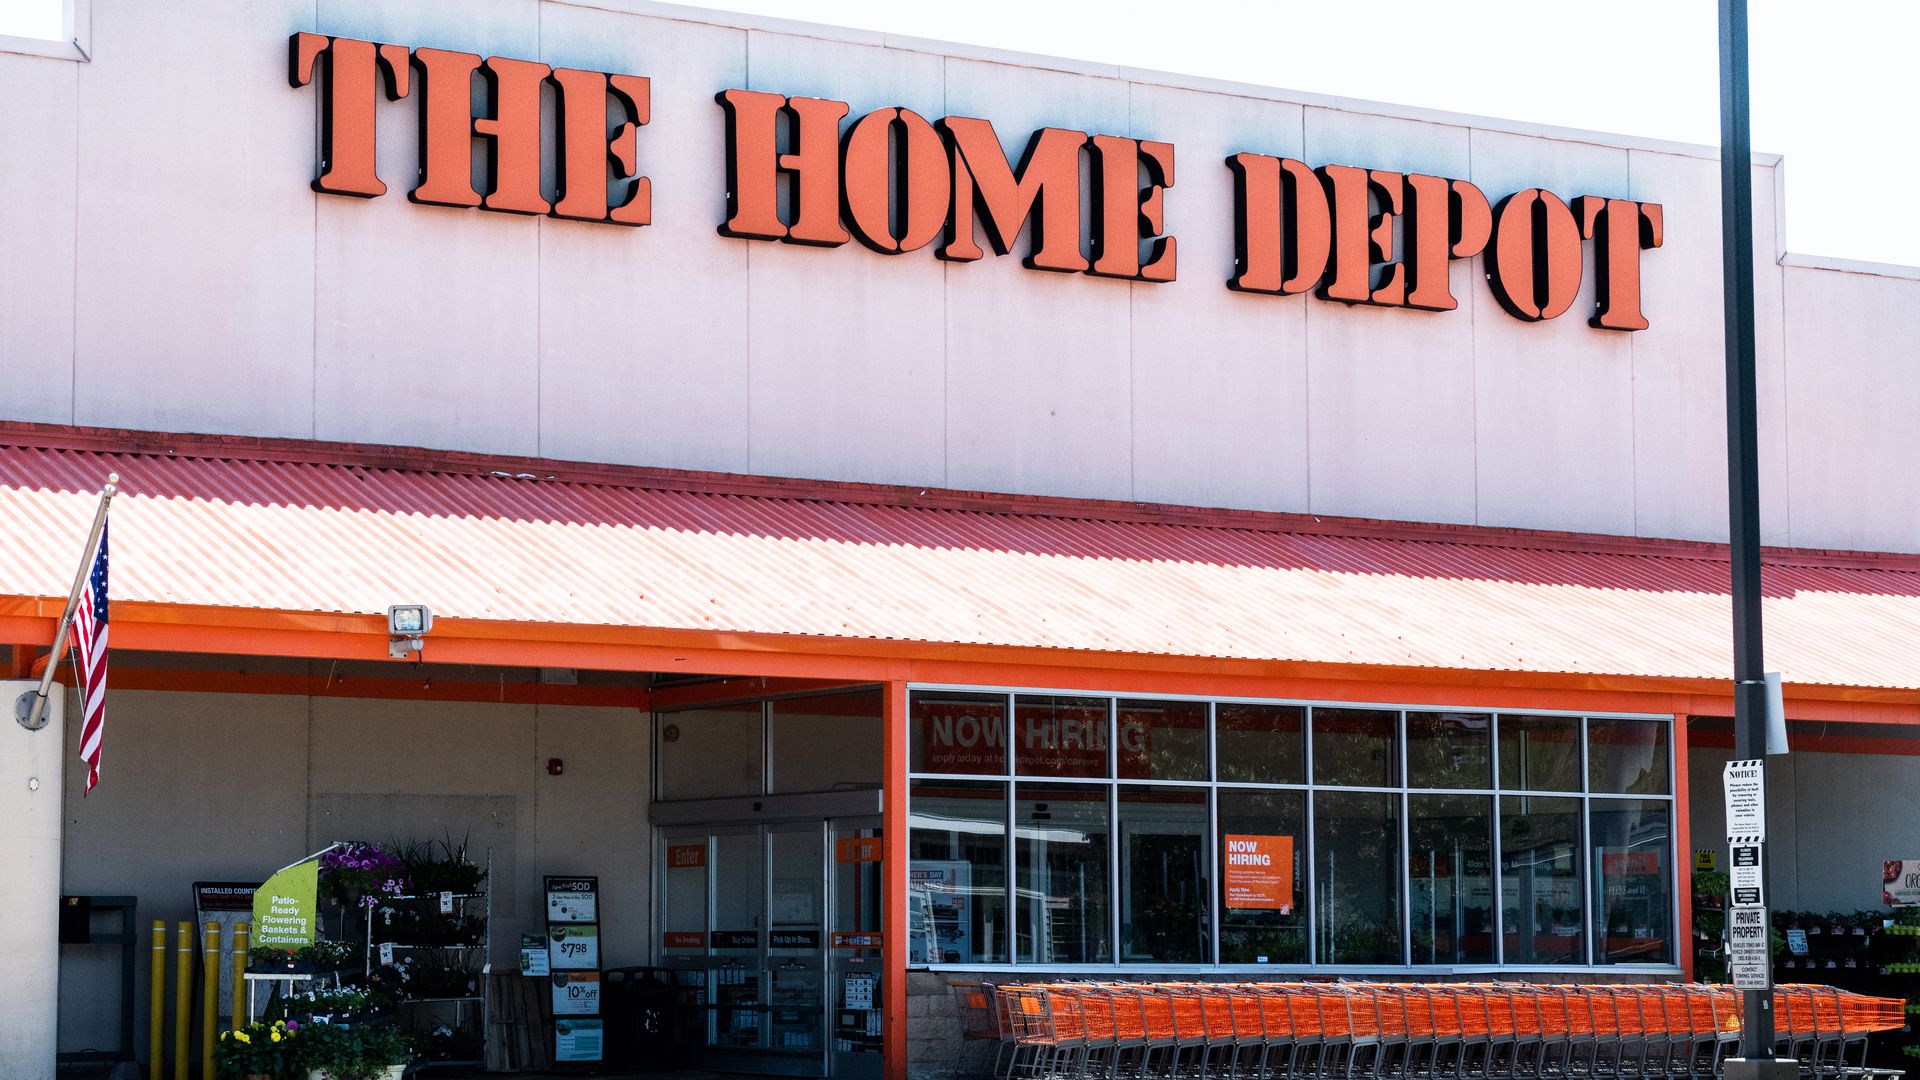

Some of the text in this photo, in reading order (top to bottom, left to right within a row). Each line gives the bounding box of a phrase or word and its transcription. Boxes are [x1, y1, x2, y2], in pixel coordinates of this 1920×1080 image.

[289, 32, 1663, 331] THE HOME DEPOT
[932, 715, 1005, 747] NOW
[930, 754, 954, 764] Apply
[956, 754, 981, 764] today
[995, 755, 1099, 767] hoedepot.com/careers
[1729, 770, 1757, 778] NOTICE!
[846, 844, 872, 860] Eer
[1229, 841, 1257, 853] NOW
[675, 848, 699, 865] Enter
[1229, 853, 1271, 866] HIRING
[571, 882, 590, 891] SOD
[272, 896, 299, 905] Patio-
[270, 906, 299, 916] Ready
[262, 915, 307, 925] Flowering
[1736, 912, 1760, 924] PRIVATE
[261, 925, 307, 934] Baskets &
[1732, 926, 1764, 938] PROPERTY
[259, 935, 308, 944] Containers
[731, 936, 739, 944] Buy
[784, 936, 791, 944] Up
[567, 986, 597, 998] 10% off
